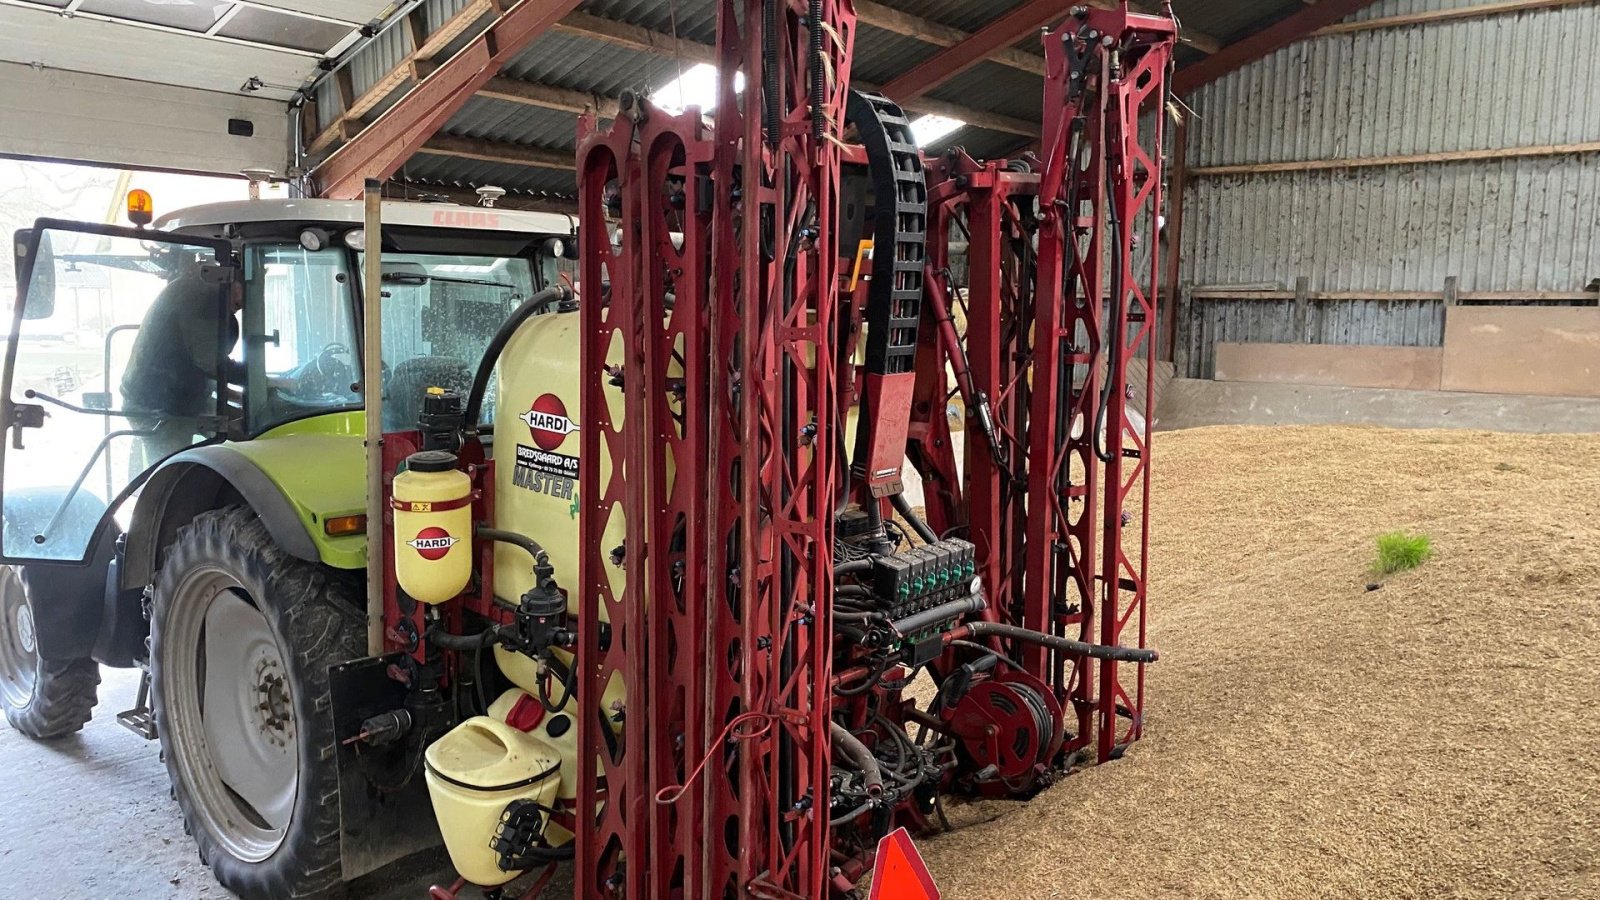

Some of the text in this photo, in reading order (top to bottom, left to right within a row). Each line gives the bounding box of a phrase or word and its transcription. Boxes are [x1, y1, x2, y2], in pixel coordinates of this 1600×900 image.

[433, 210, 498, 228] CLAAS
[530, 412, 567, 432] HARDI
[517, 446, 563, 465] BREDSGAARD
[563, 458, 578, 470] A/S
[512, 464, 574, 500] MASTER
[416, 537, 451, 548] HARDI
